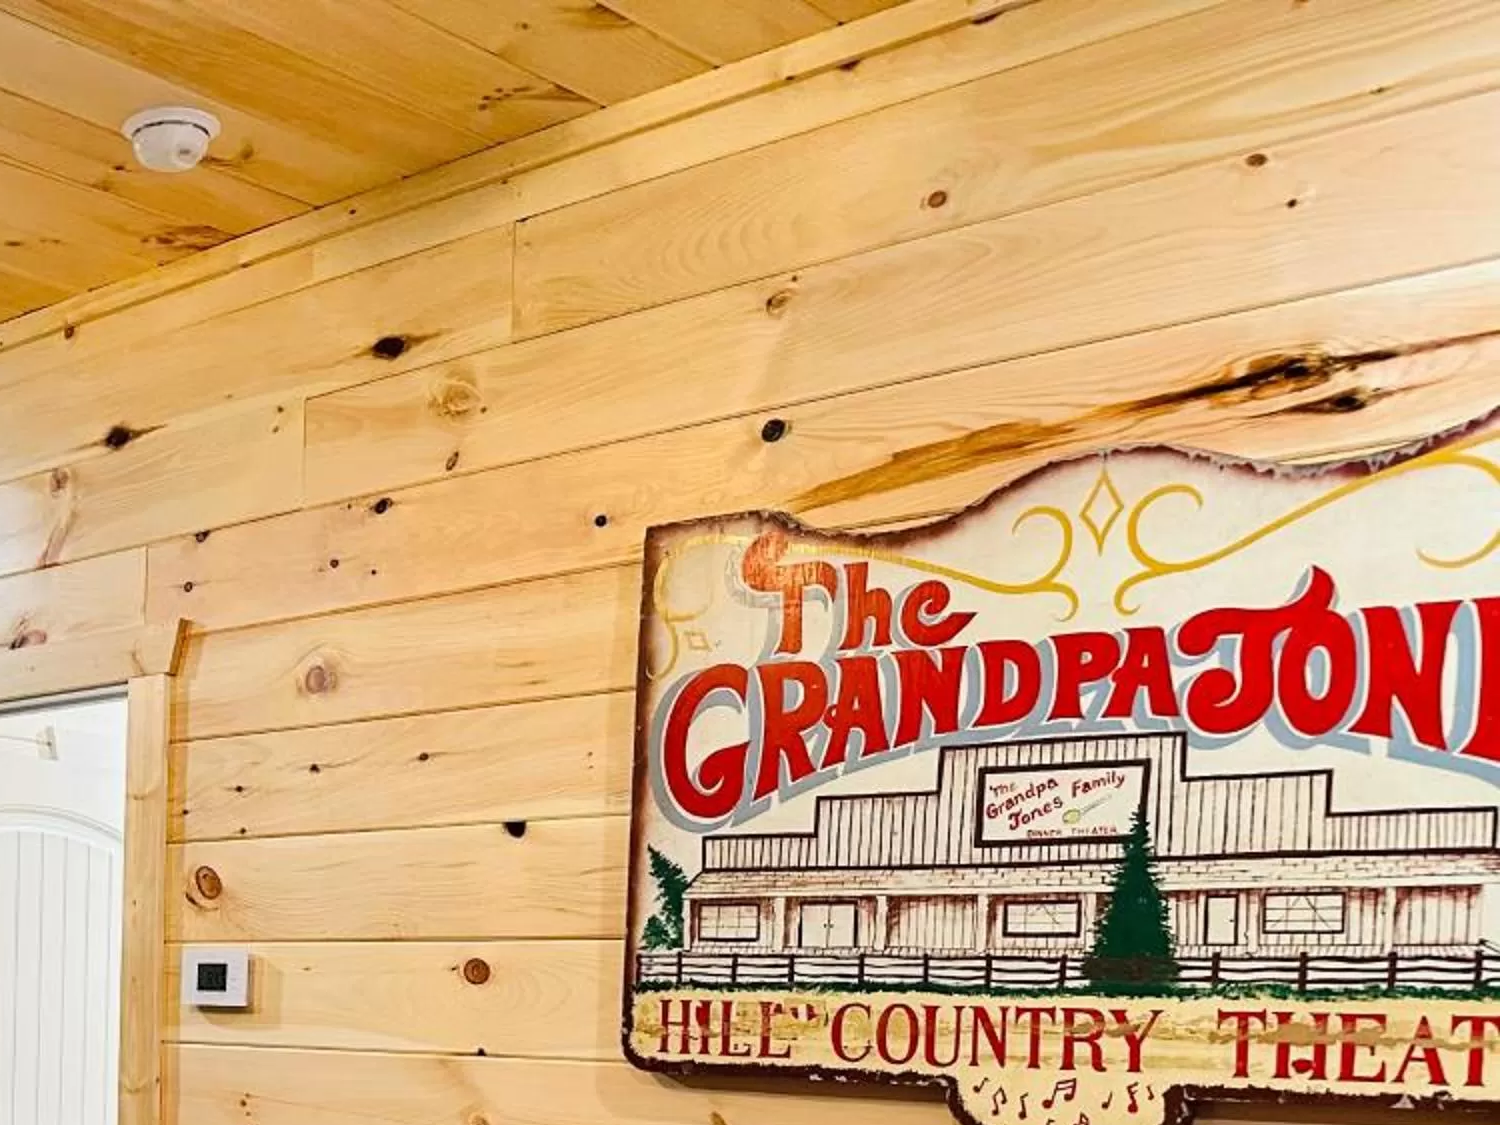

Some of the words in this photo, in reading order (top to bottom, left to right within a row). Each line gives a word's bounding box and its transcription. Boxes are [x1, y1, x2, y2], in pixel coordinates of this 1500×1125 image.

[741, 530, 978, 655] The
[660, 623, 1181, 821] GRANDPA
[986, 778, 1059, 819] Grandpa
[1008, 796, 1064, 831] Jones
[1071, 771, 1126, 798] Family
[657, 999, 792, 1059] HILL
[830, 1002, 1165, 1073] COUNTRY
[1216, 1007, 1500, 1087] THEAT
